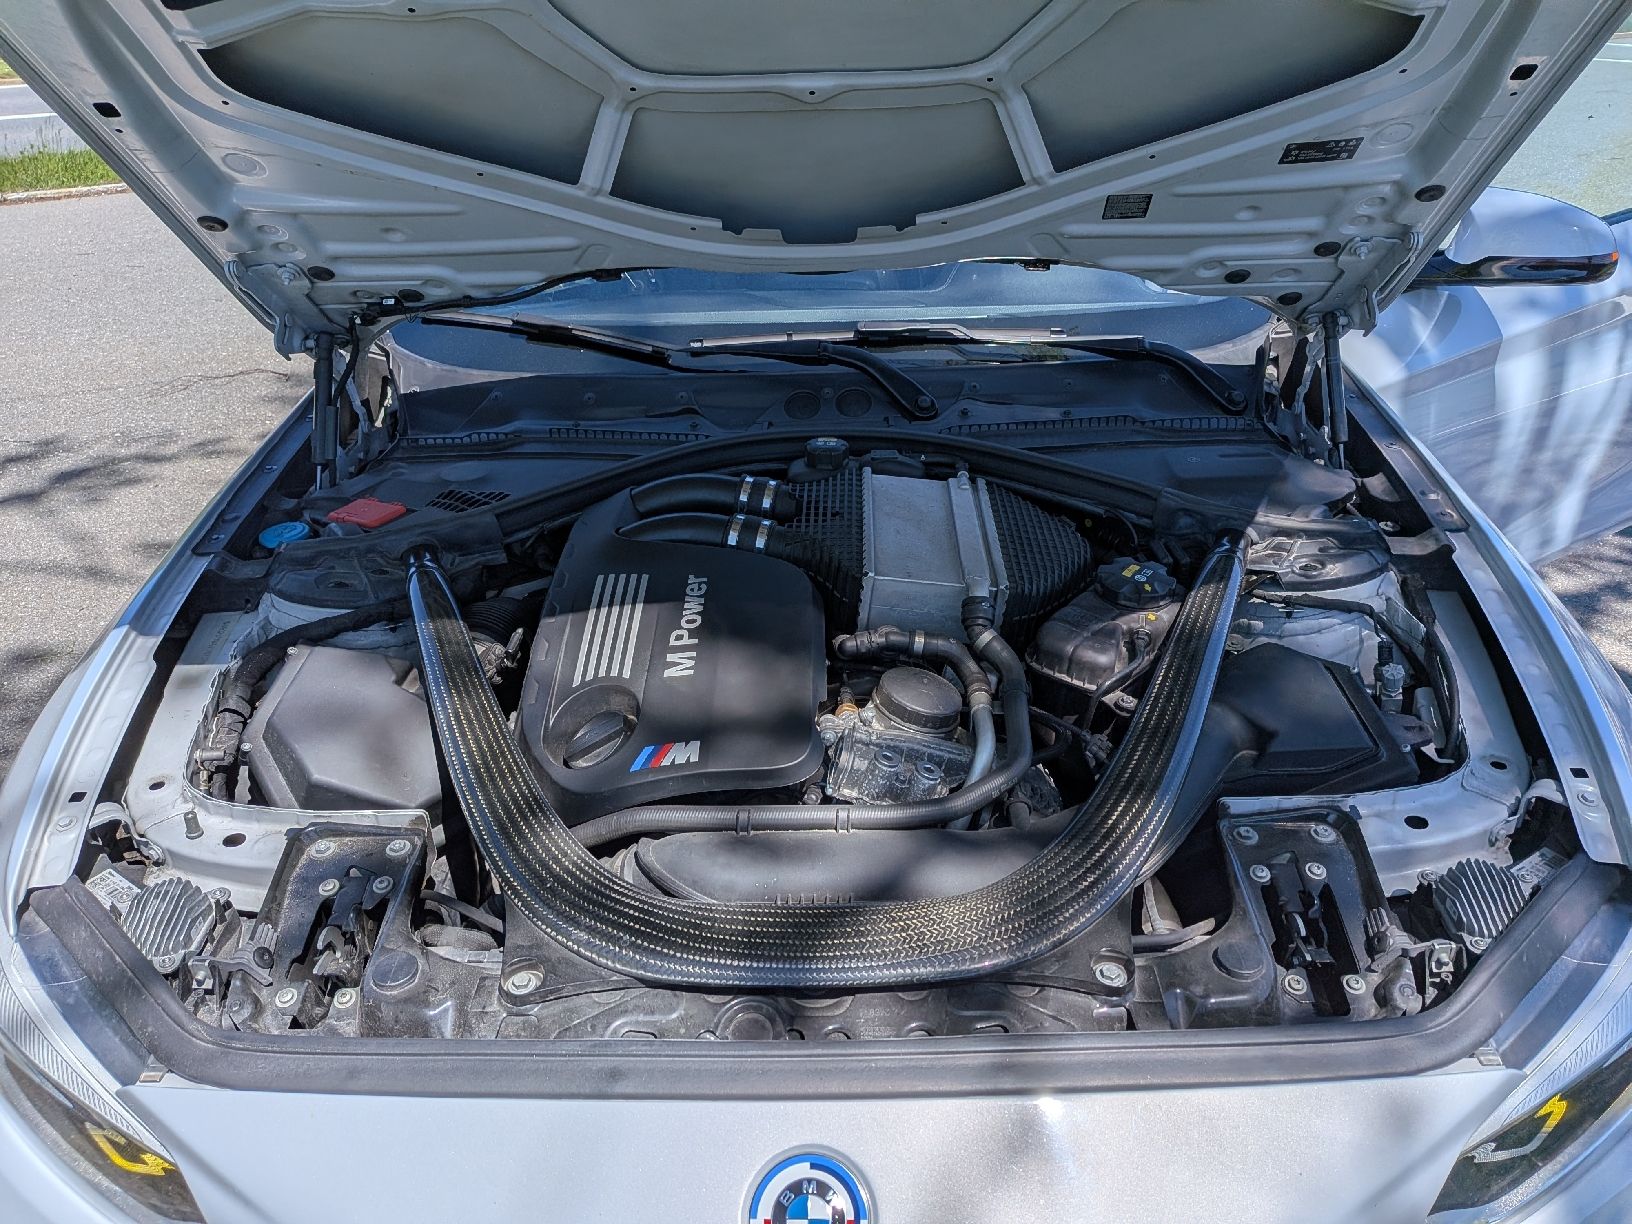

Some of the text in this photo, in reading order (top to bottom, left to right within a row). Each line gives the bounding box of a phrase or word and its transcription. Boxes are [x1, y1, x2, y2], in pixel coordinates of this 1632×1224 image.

[663, 574, 708, 678] M Power
[660, 740, 701, 767] M
